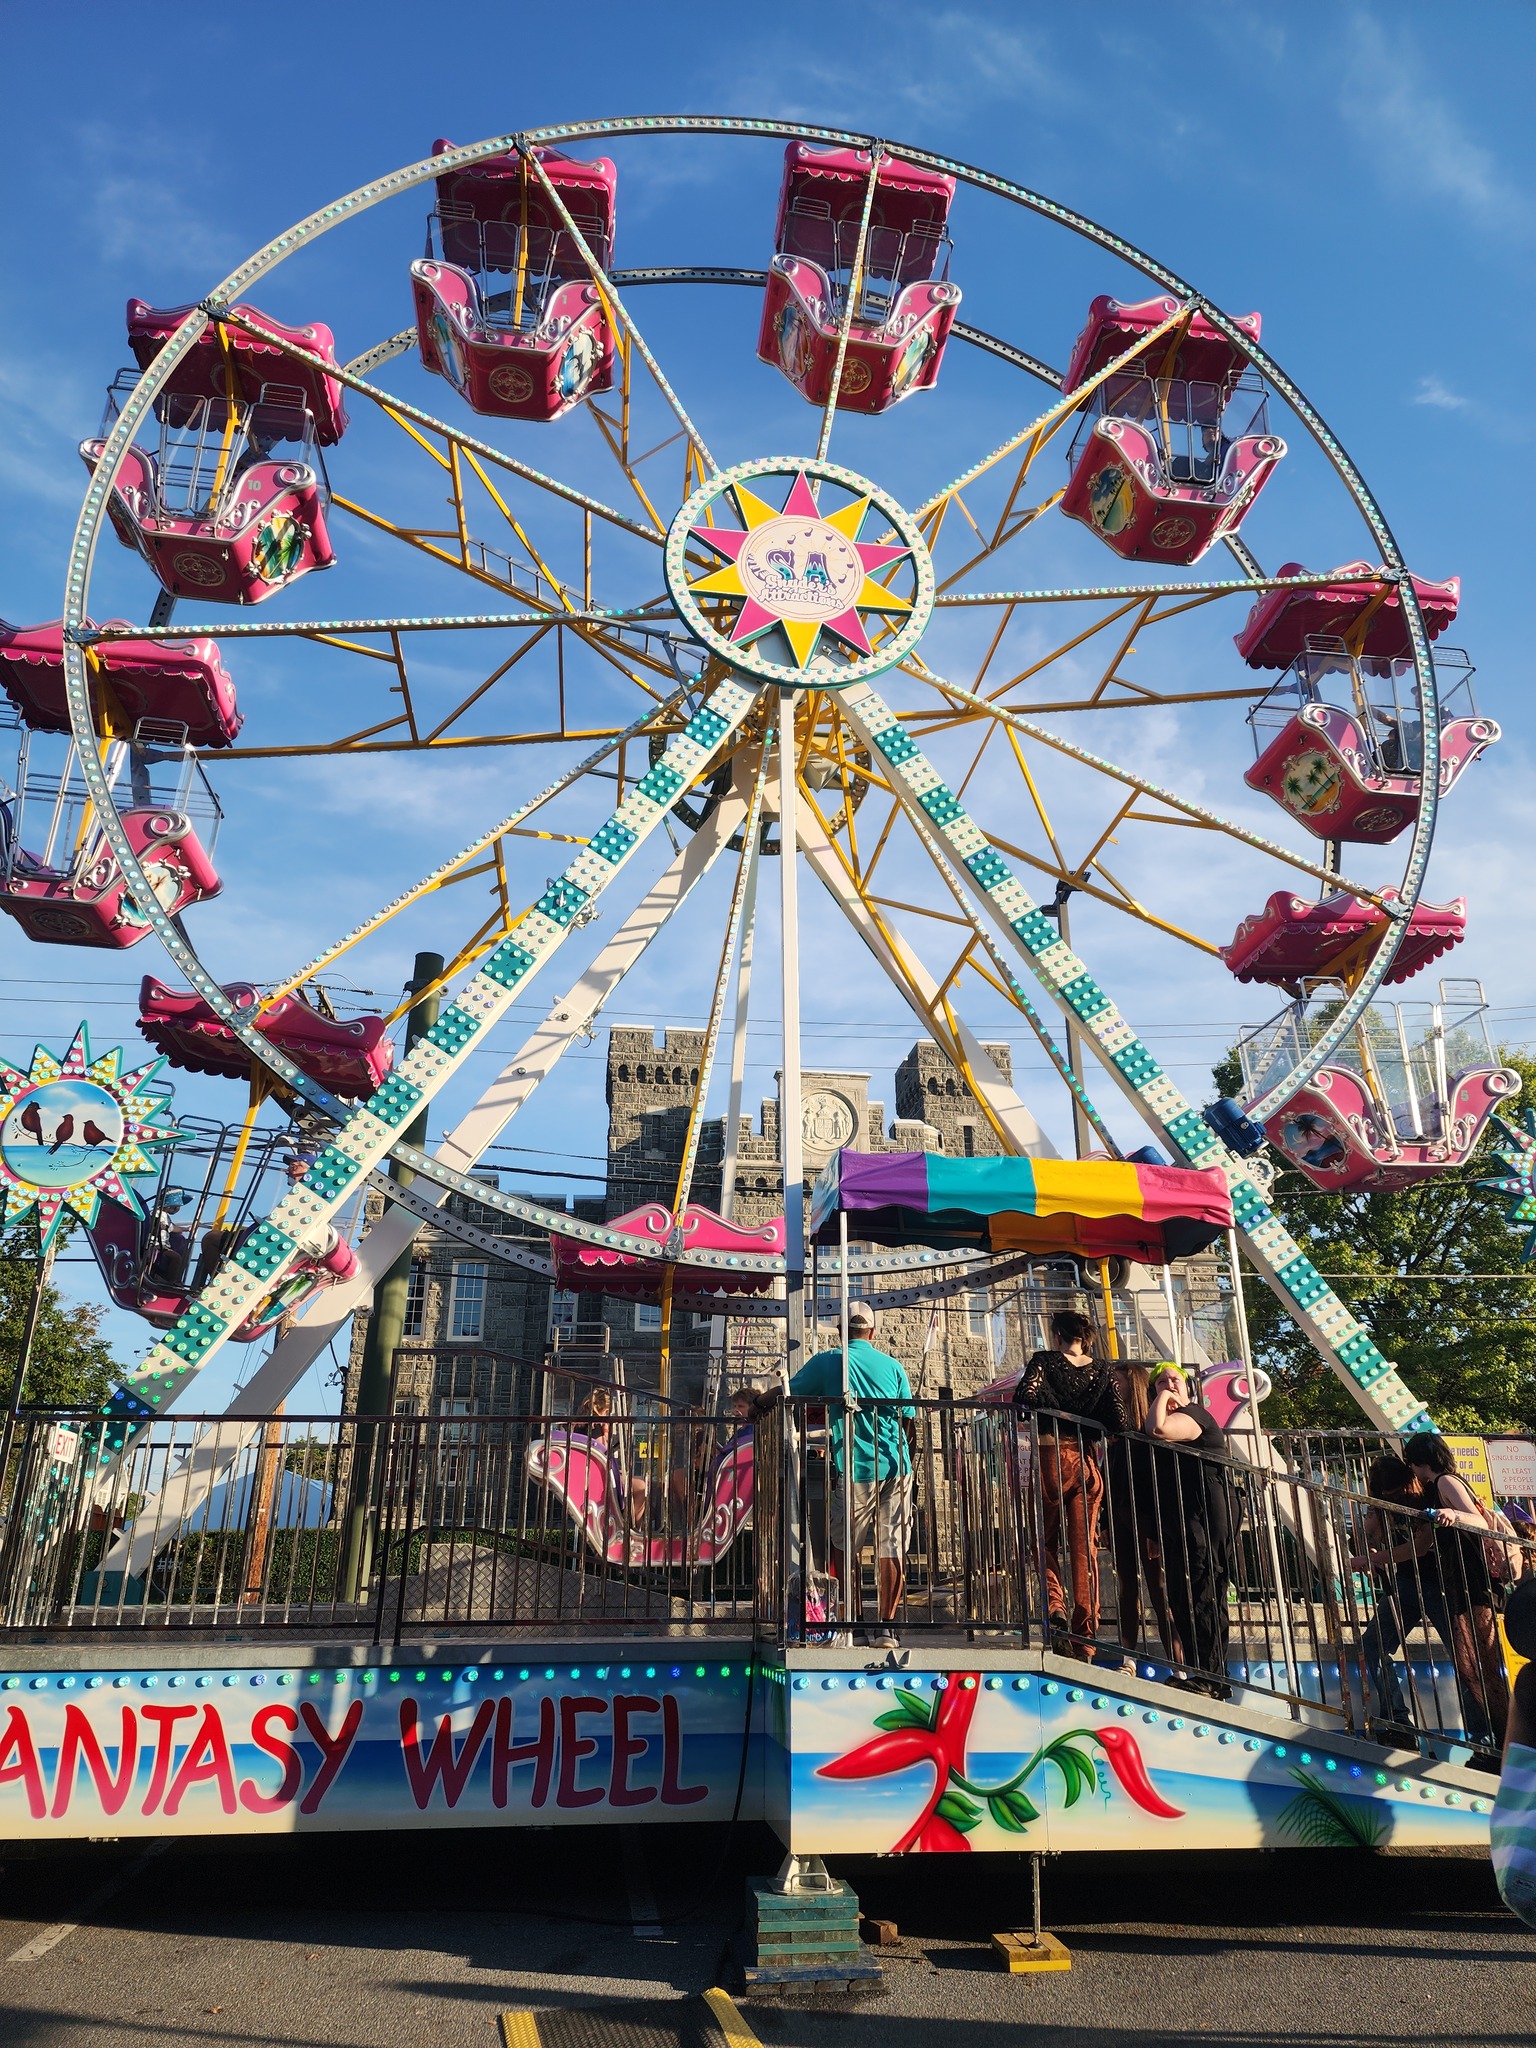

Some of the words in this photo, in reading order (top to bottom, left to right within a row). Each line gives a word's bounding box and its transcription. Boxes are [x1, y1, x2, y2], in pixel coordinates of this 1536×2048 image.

[247, 479, 262, 491] 10
[765, 574, 837, 595] Snyder's
[758, 588, 845, 609] Attractions
[1461, 1089, 1469, 1101] 5
[56, 1434, 74, 1457] EXIT
[1456, 1446, 1479, 1457] needs
[1506, 1445, 1519, 1453] NO
[1459, 1460, 1467, 1470] or
[1501, 1467, 1511, 1475] AT
[1512, 1467, 1532, 1475] LEAST
[1471, 1471, 1486, 1483] ride
[399, 1694, 710, 1810] WHEEL
